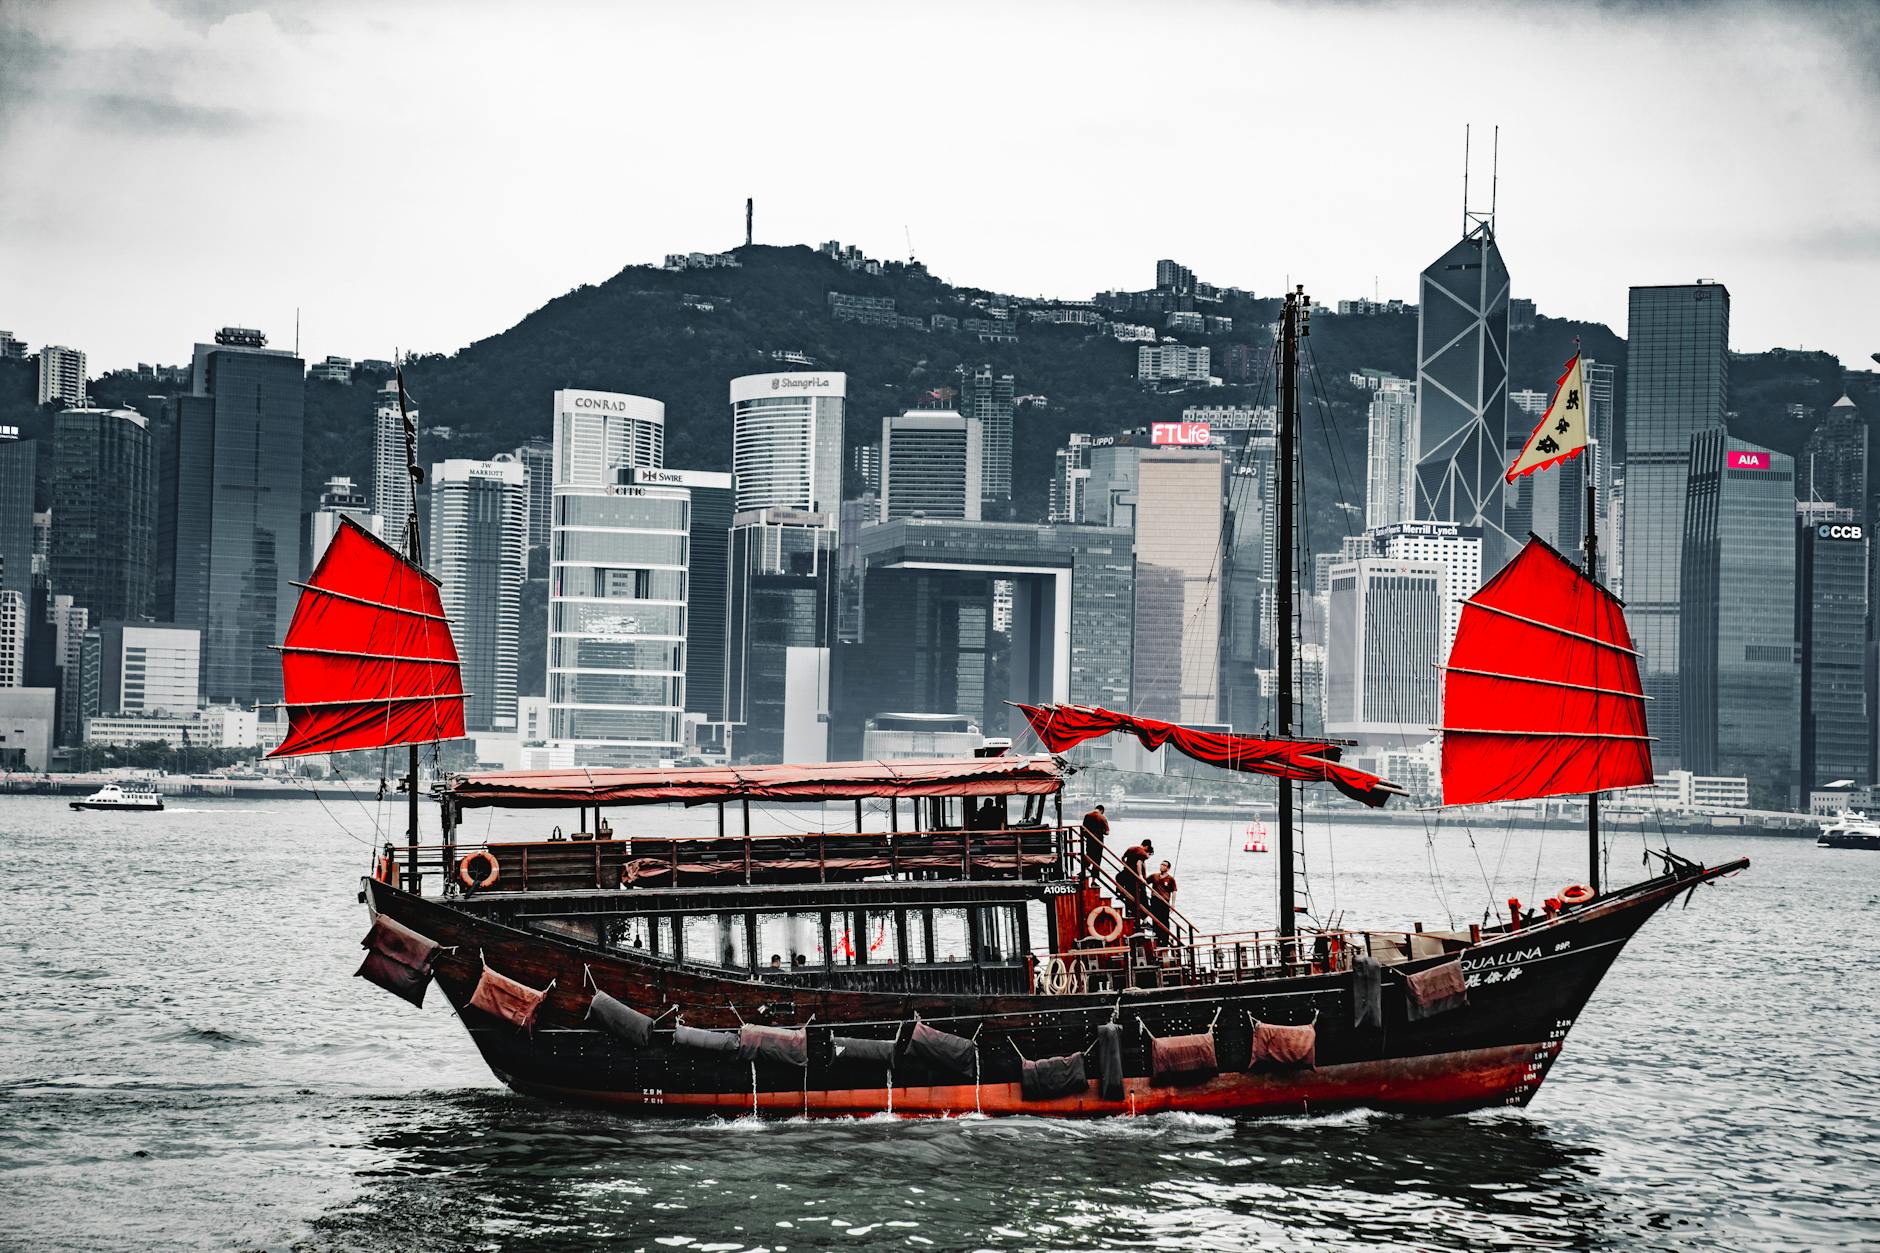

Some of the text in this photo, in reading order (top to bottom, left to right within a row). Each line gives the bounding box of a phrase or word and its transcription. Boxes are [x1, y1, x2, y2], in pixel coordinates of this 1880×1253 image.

[575, 397, 626, 411] CONRAD
[1152, 424, 1210, 444] FTLife
[1093, 437, 1113, 447] LIPPO
[1738, 455, 1759, 465] AIA
[470, 469, 504, 477] MARRIOTT
[1232, 466, 1257, 476] LPPO
[1402, 523, 1431, 535] Merrill
[1432, 525, 1458, 536] Lynch
[1830, 525, 1862, 539] CCB
[1461, 956, 1495, 971] QUA
[1497, 946, 1542, 966] LUNA
